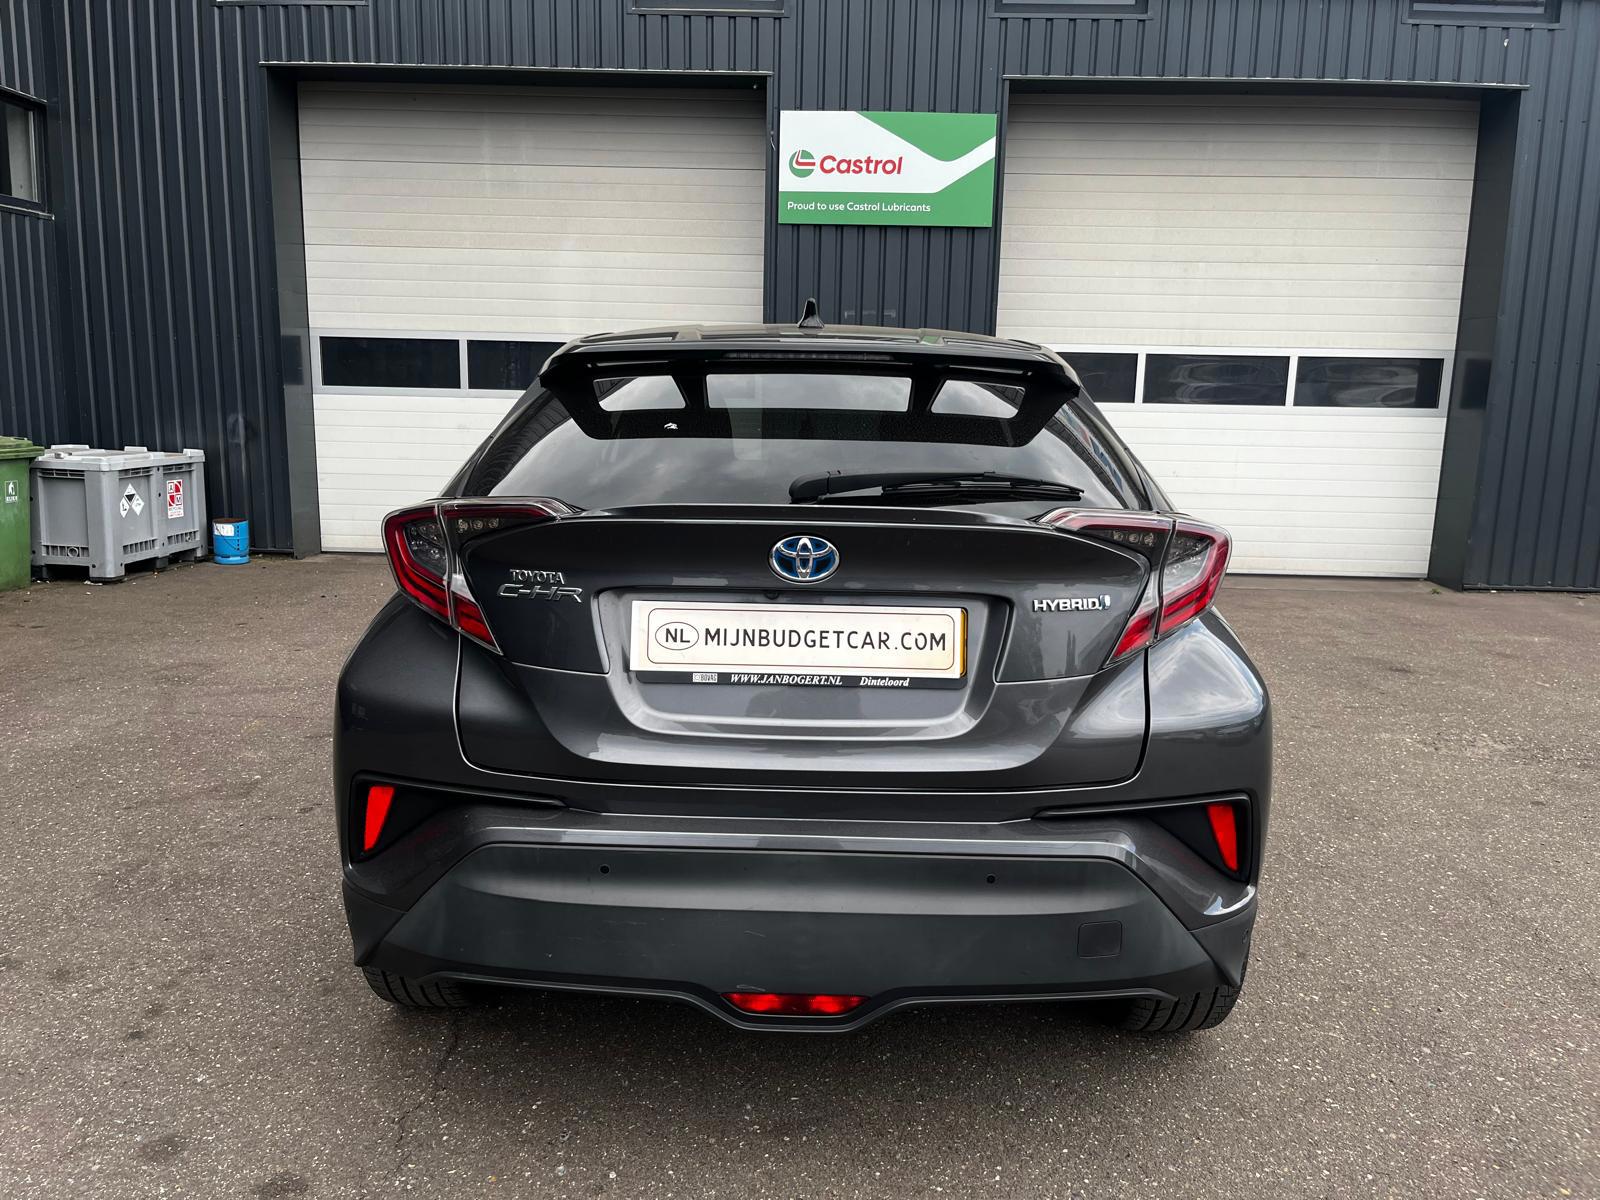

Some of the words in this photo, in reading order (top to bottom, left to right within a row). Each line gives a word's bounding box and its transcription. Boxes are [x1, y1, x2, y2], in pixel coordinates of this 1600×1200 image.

[819, 155, 903, 175] Castrol
[787, 201, 815, 211] Proud
[817, 203, 827, 211] to
[846, 202, 880, 212] Castrol
[882, 203, 931, 213] Lubricants
[510, 569, 565, 585] TOYOTA
[497, 583, 583, 603] C-HR
[1033, 598, 1102, 612] HYBRID
[665, 628, 691, 644] NL
[704, 627, 946, 652] MIJNBUDGETCAR.COM
[730, 673, 843, 686] WWW.JANBOGERT.NL
[859, 676, 910, 687] Dinteloord
